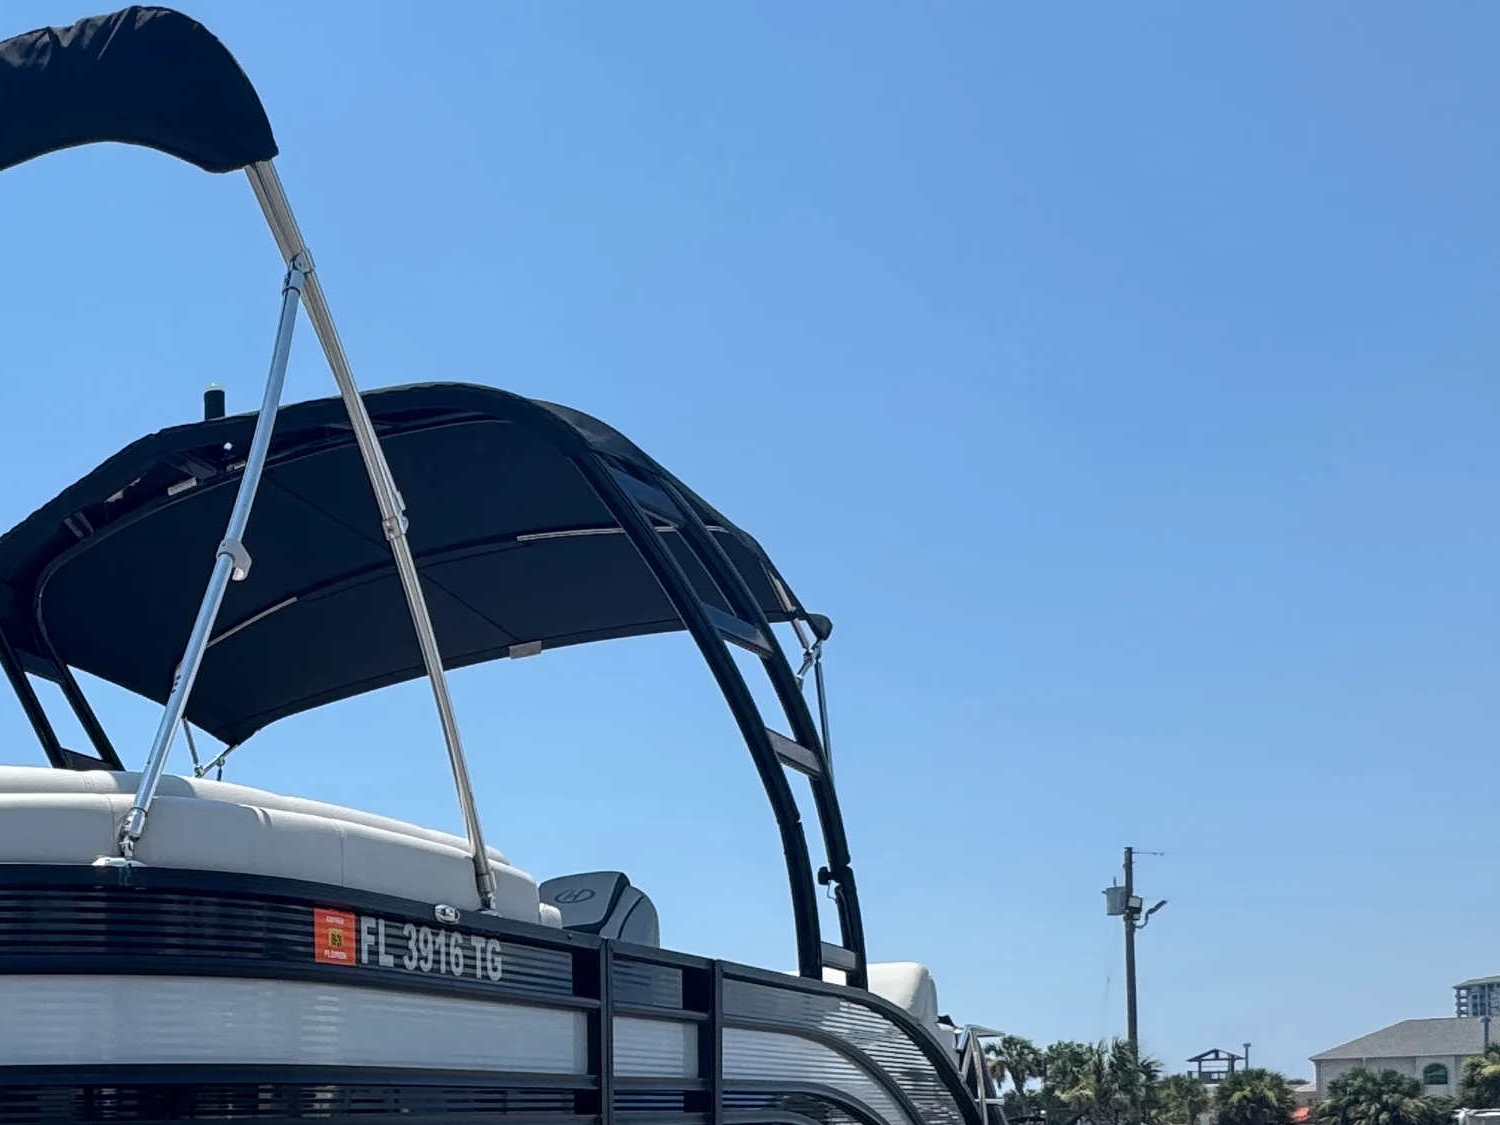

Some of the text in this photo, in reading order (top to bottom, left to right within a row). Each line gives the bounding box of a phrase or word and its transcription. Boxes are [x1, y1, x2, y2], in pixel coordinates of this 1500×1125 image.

[360, 915, 502, 981] FL 3916 TG
